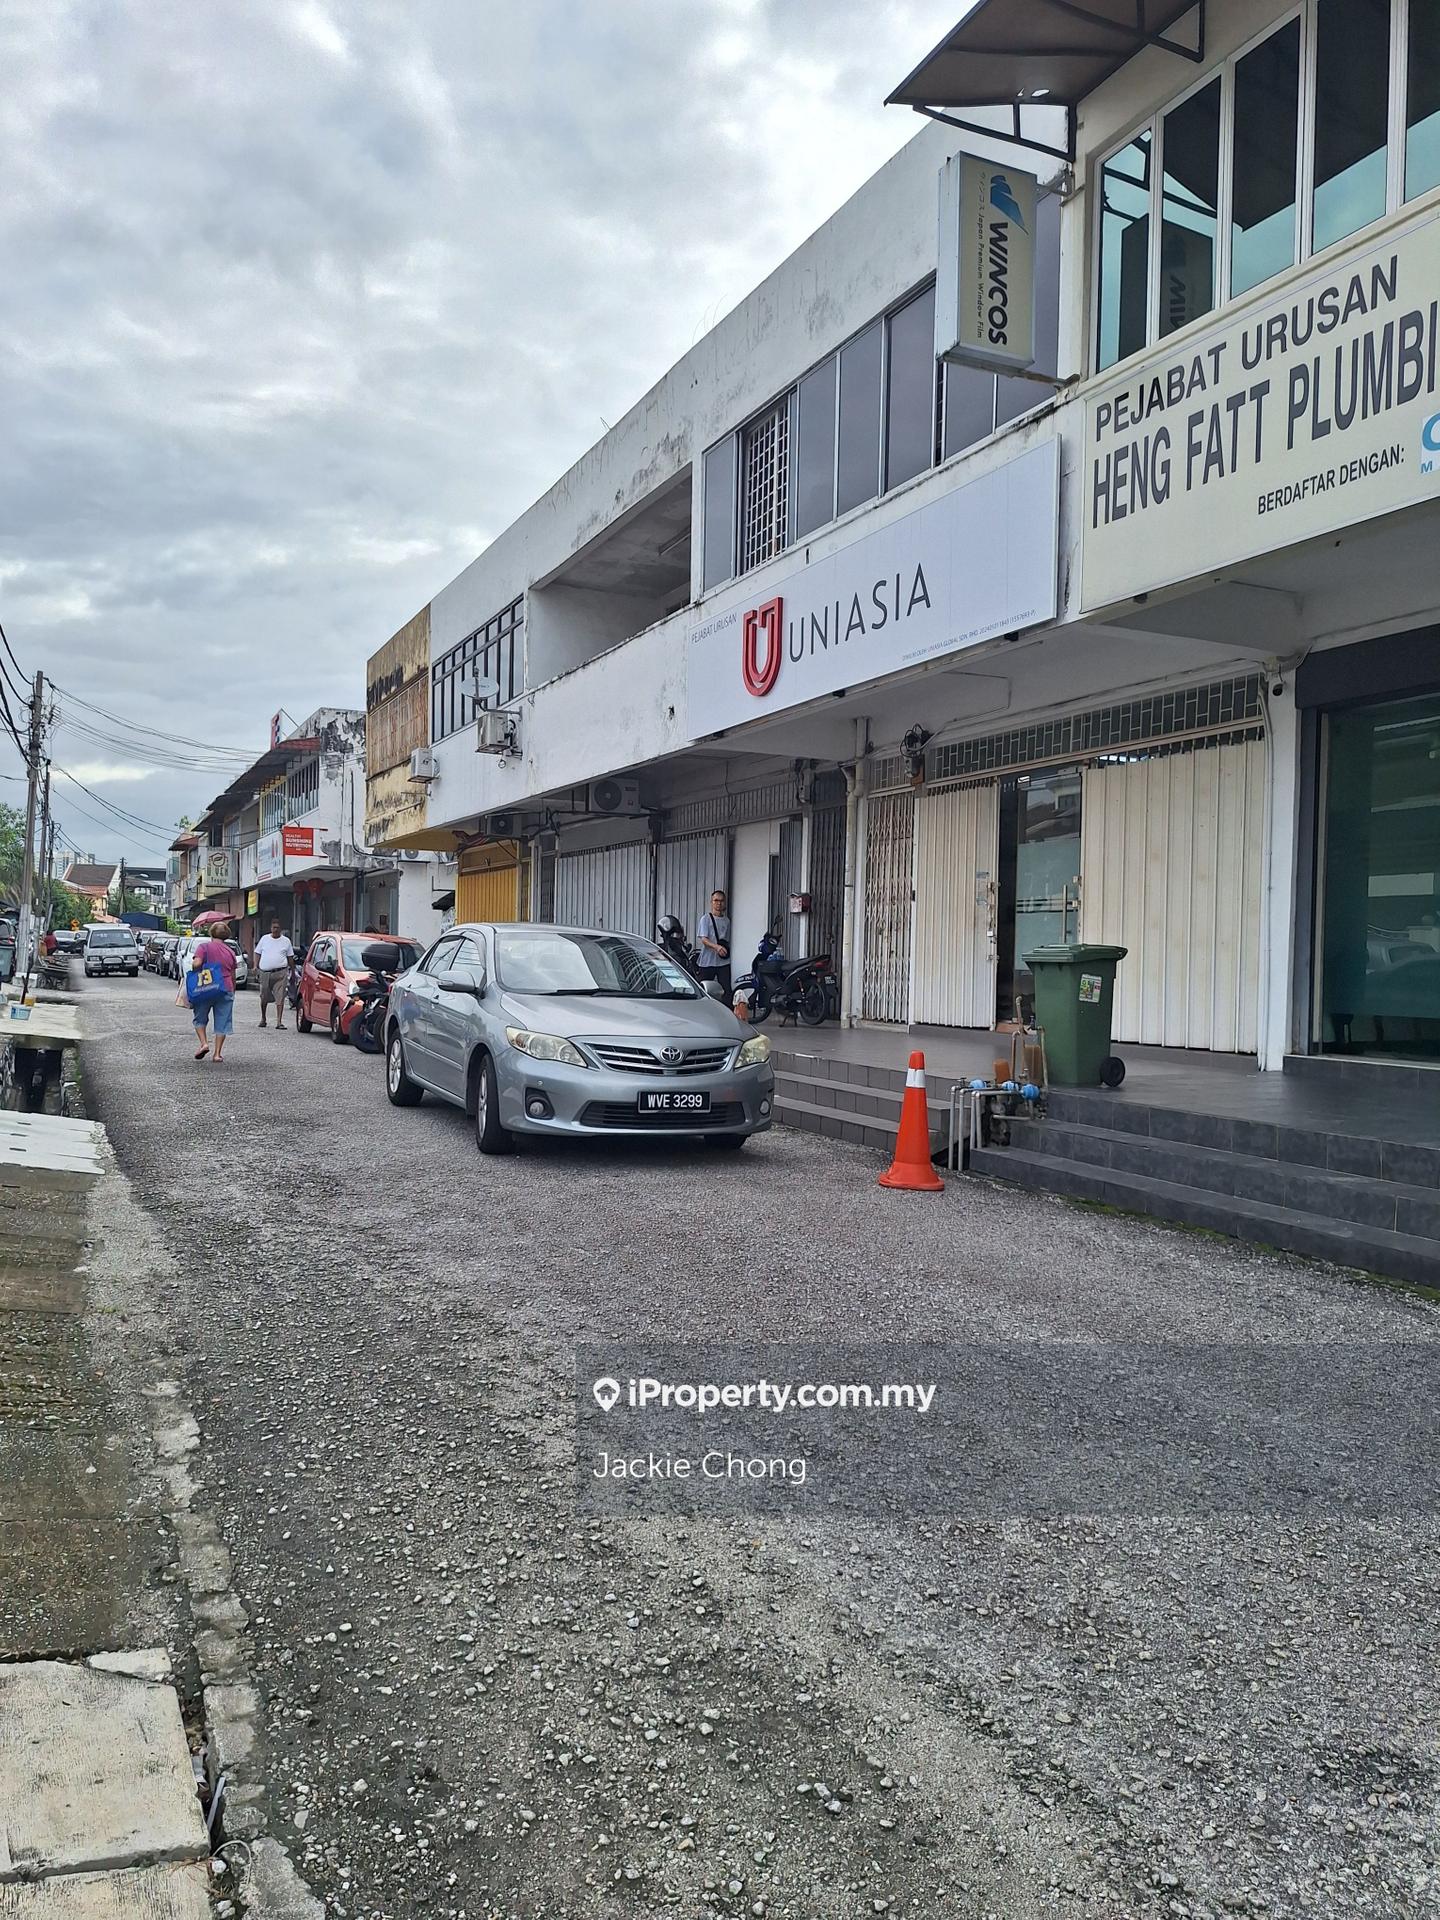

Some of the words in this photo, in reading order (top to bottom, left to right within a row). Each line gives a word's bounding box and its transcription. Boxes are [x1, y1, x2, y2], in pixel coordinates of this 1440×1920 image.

[977, 213, 985, 239] Japan
[977, 242, 985, 279] Premium
[977, 283, 985, 318] Window
[987, 221, 1009, 346] WINCOS
[1095, 341, 1227, 442] PEJABAT
[1241, 254, 1398, 371] URUSAN
[1092, 426, 1171, 529] HENG
[1185, 379, 1270, 491] FATT
[1286, 300, 1438, 451] PLUMBI
[1257, 469, 1336, 515] BERDAFTAR
[1339, 443, 1405, 486] DENGAN:
[789, 562, 931, 662] UNIASIA
[647, 1094, 670, 1108] WVE
[673, 1094, 703, 1108] 3299
